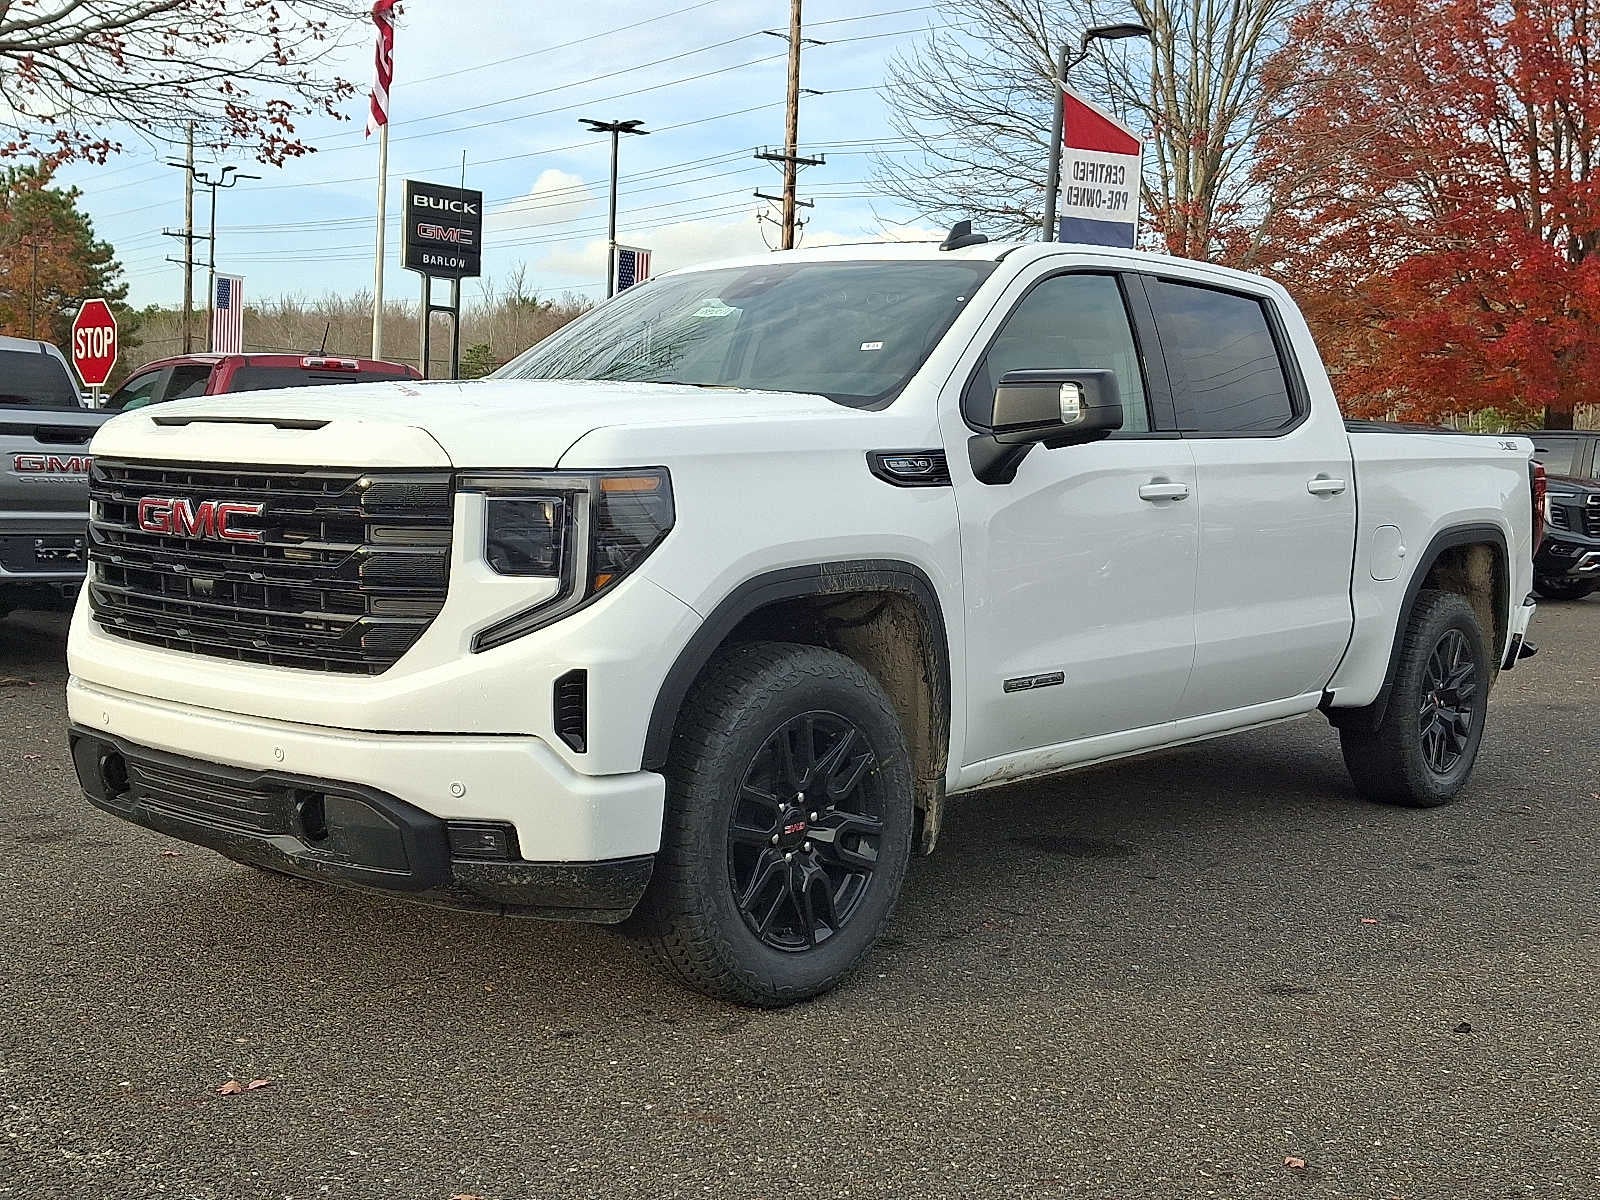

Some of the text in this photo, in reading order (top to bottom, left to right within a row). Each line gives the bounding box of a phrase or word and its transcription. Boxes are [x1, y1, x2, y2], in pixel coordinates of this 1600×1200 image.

[413, 194, 478, 215] BUICK
[417, 223, 473, 245] GMC
[423, 253, 466, 269] BARLOW
[75, 326, 114, 360] STOP
[137, 496, 266, 543] GMC
